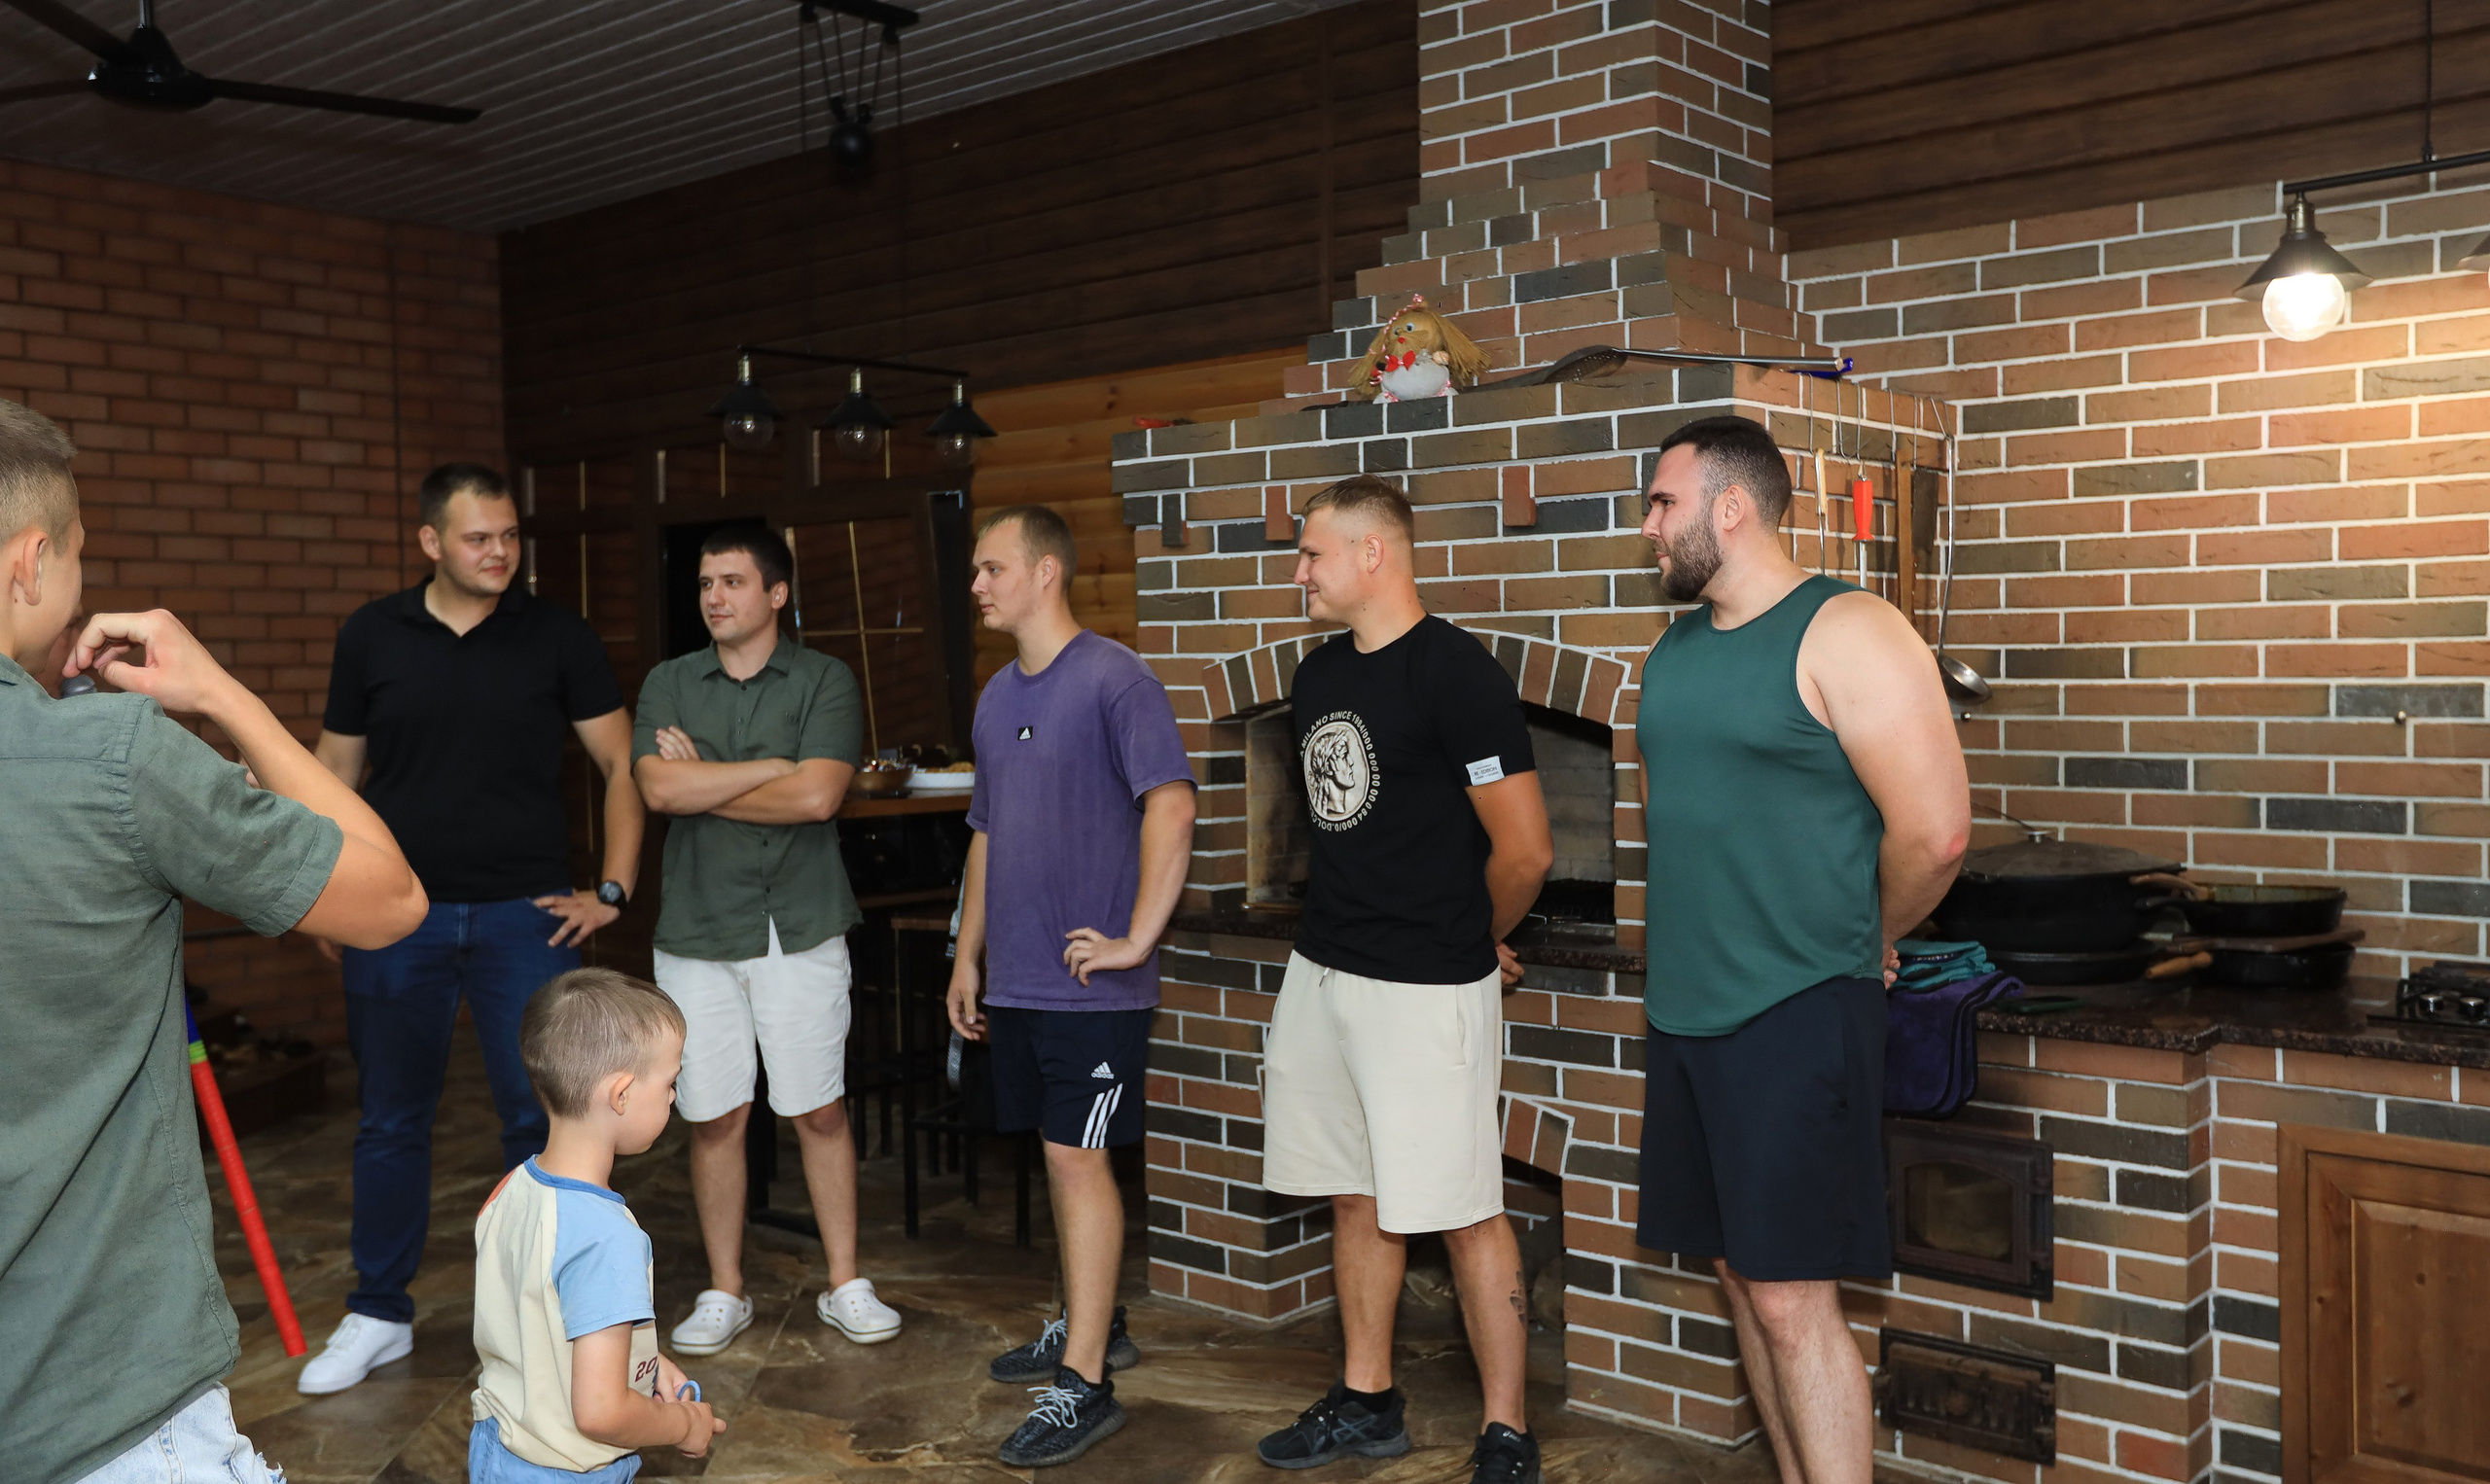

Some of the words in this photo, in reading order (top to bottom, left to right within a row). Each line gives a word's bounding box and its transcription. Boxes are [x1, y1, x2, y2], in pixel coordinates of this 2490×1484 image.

[1301, 715, 1328, 748] MILANO
[1329, 711, 1352, 721] SINCE
[635, 1355, 658, 1383] 20
